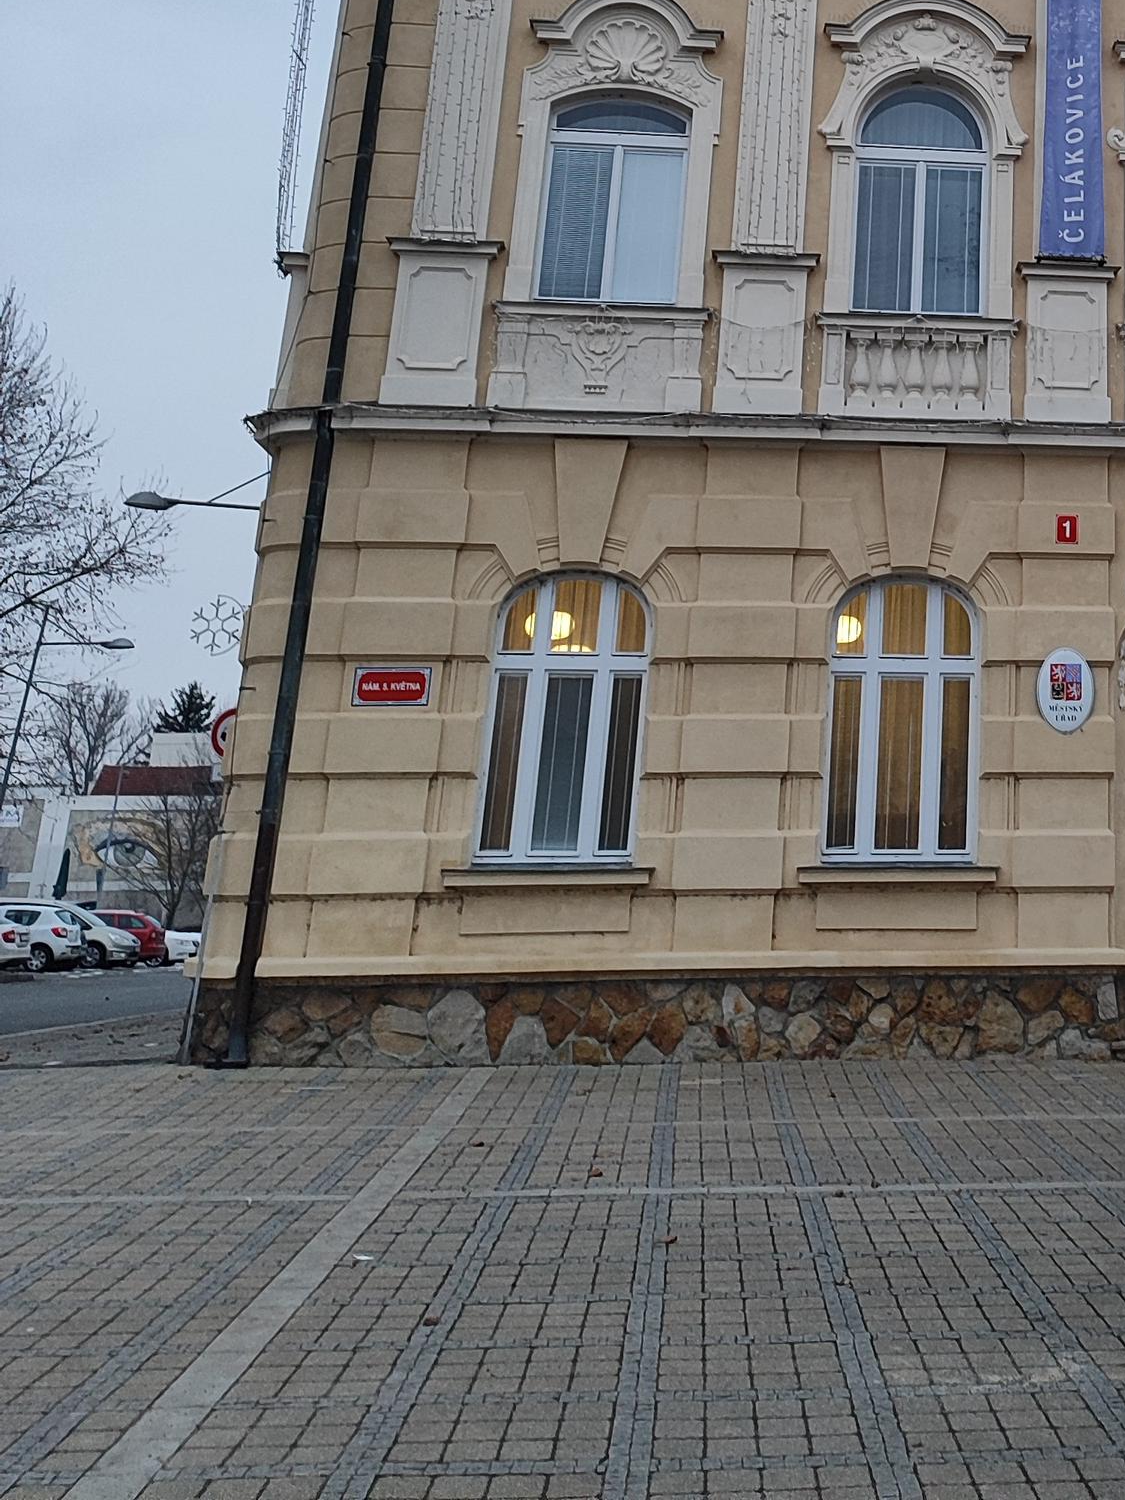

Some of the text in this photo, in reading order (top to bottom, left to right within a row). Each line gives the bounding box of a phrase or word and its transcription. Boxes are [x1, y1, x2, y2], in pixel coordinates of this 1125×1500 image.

[1058, 55, 1084, 243] ČELÁKOVICE
[1062, 520, 1070, 538] 1
[362, 681, 380, 691] NÁM.
[390, 681, 421, 691] KVĚTNA
